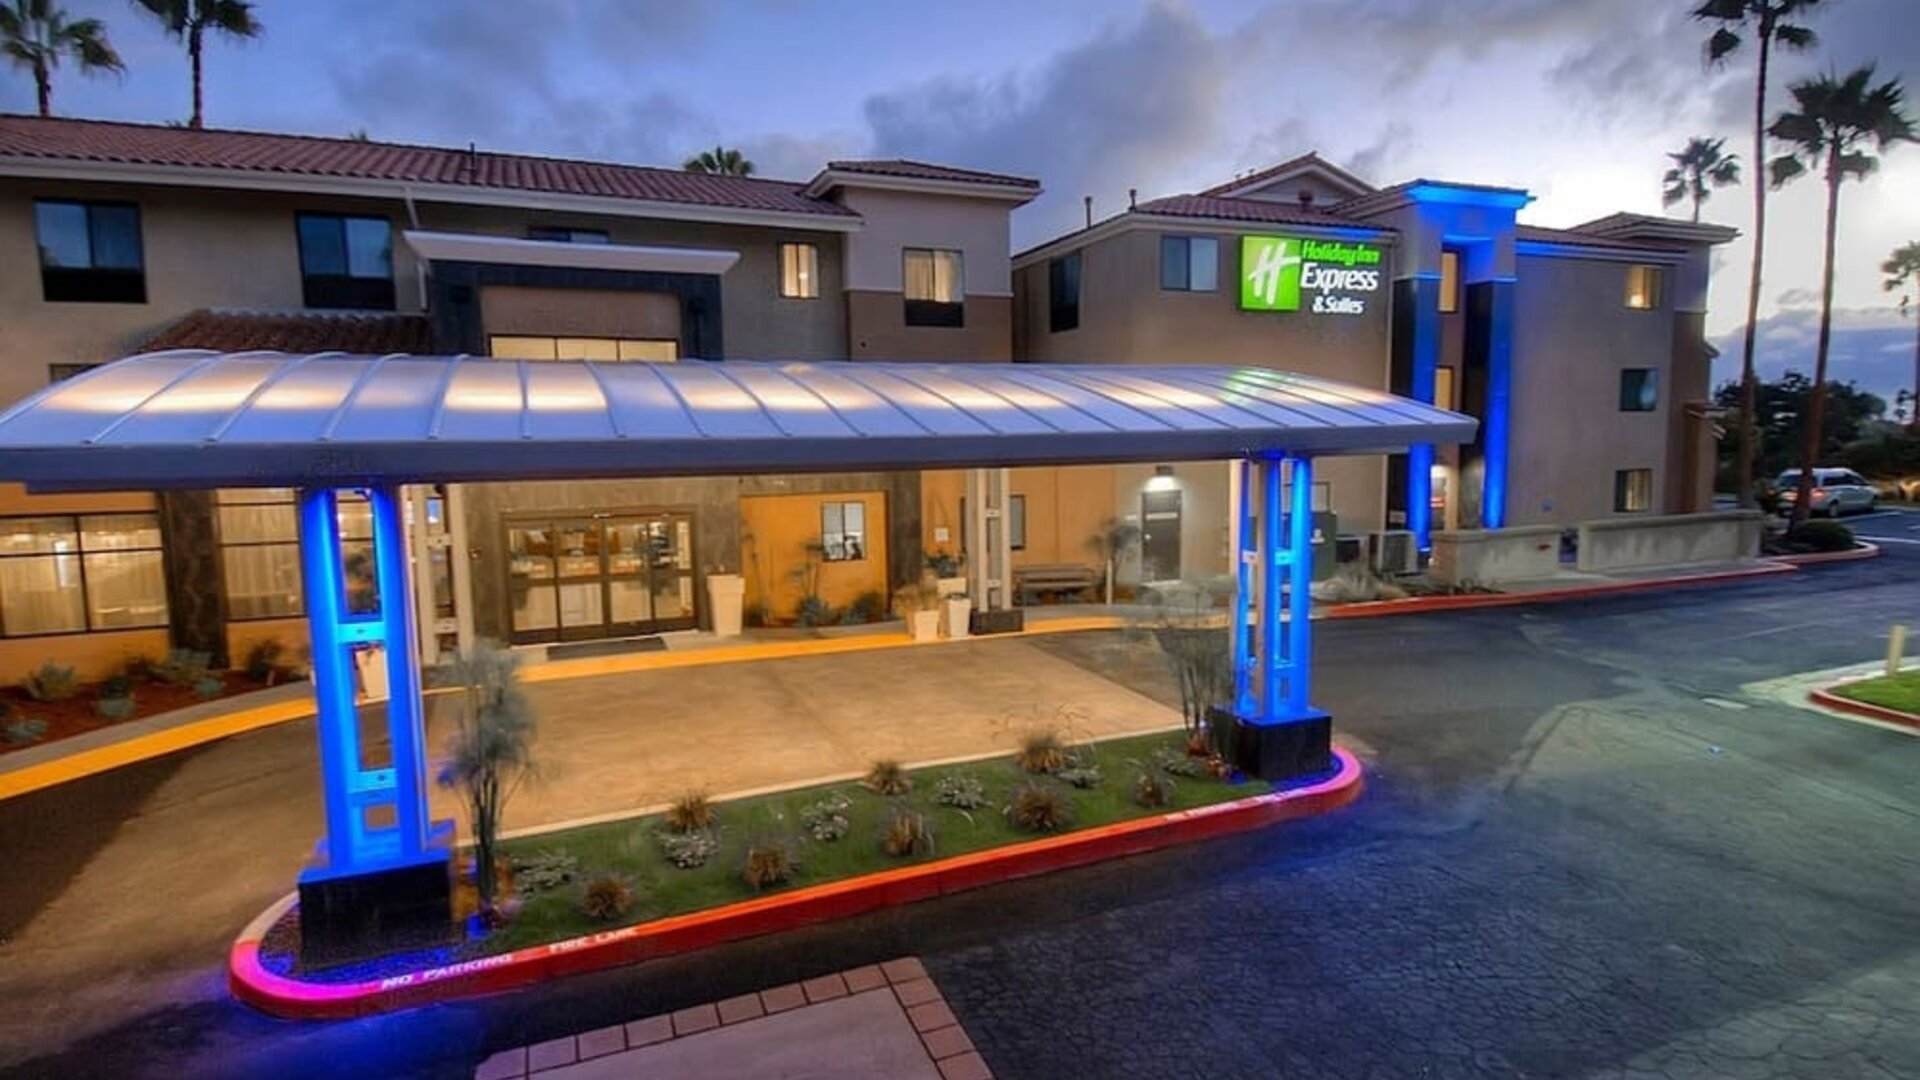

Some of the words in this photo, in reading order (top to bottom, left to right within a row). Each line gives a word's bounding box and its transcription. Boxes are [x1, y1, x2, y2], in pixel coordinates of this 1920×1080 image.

[1303, 240, 1357, 266] Holiday
[1356, 244, 1380, 264] Inn
[1300, 262, 1380, 295] Express
[1312, 296, 1325, 313] &
[1325, 296, 1365, 314] Suites
[381, 973, 413, 991] NO
[423, 952, 515, 980] PARKING
